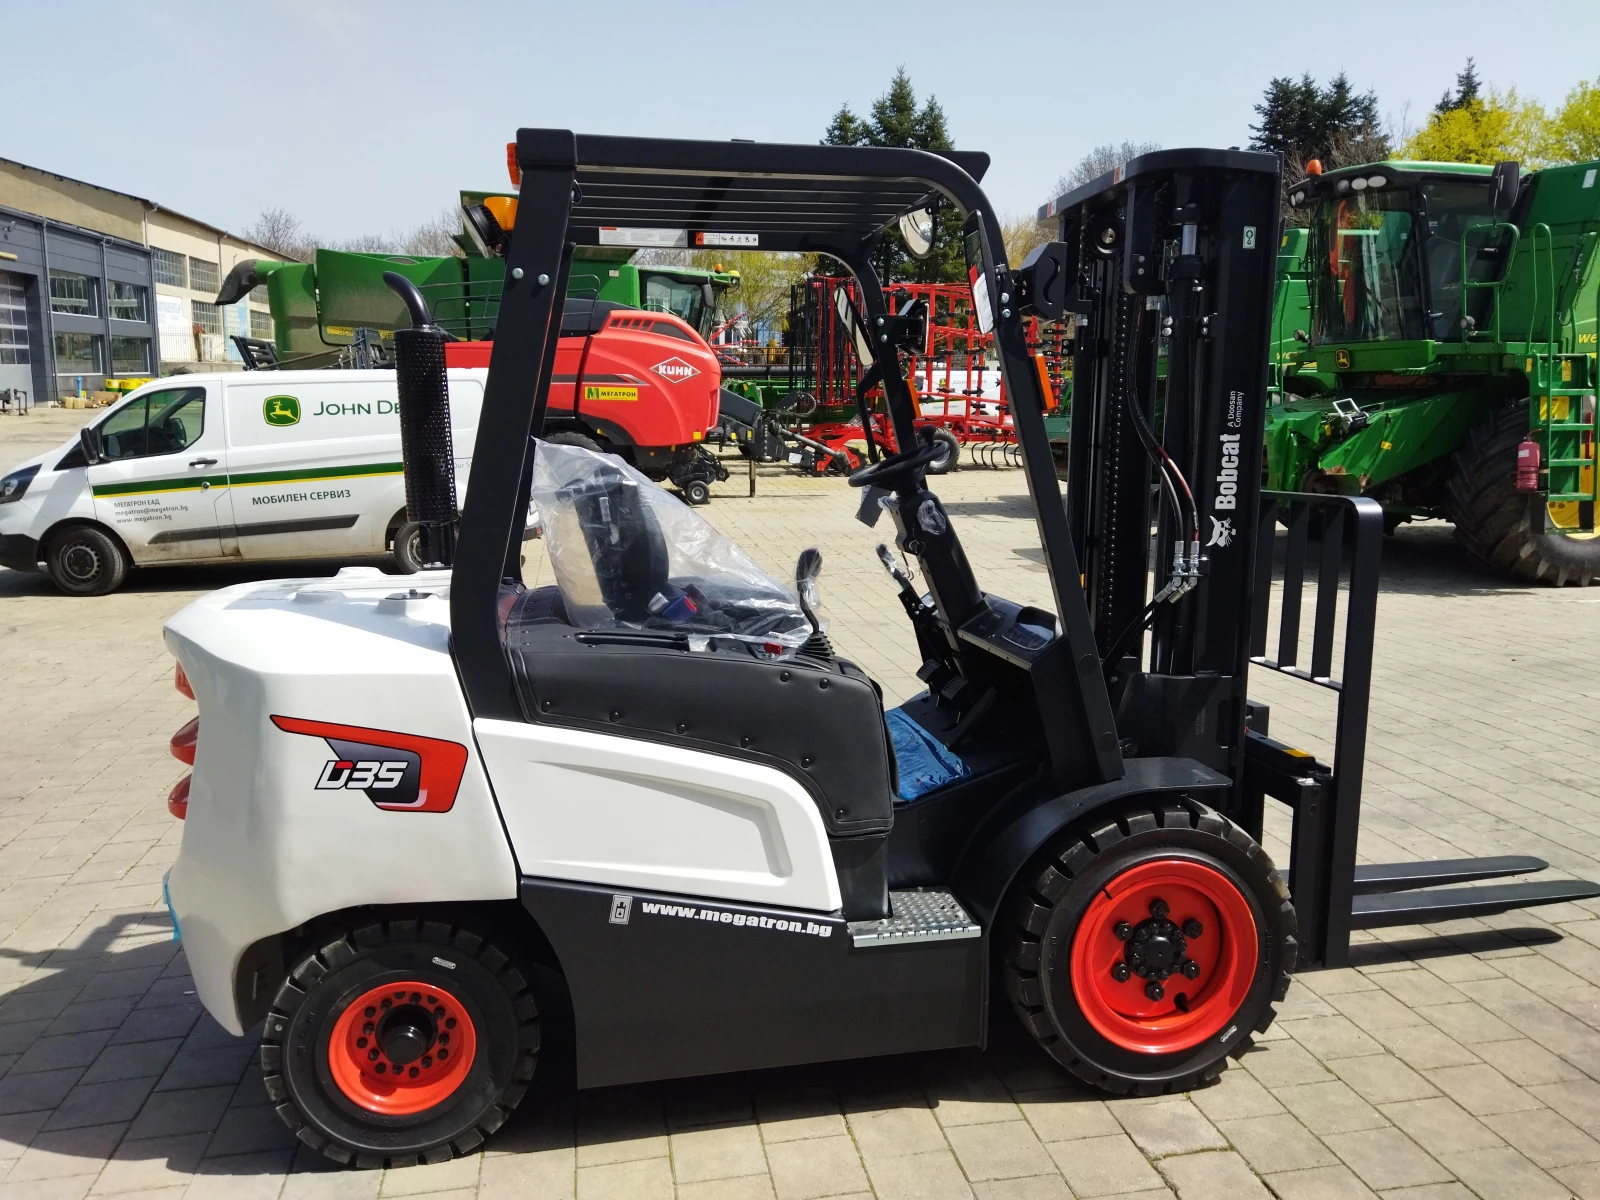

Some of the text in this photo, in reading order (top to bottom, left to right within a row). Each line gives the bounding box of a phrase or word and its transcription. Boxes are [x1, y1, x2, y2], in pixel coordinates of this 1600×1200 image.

[658, 364, 693, 376] KUHN
[313, 399, 400, 416] JOHN DE
[1228, 390, 1236, 419] Doosan
[1233, 391, 1244, 428] Company
[1215, 433, 1240, 509] Bobcat
[114, 498, 160, 508] МЕГАТРОН ЕАД
[252, 489, 351, 506] МОБИЛЕН СЕРВИЗ
[115, 505, 188, 516] megatron@megatron.bg
[117, 514, 172, 524] www.megatron.bg
[314, 760, 409, 790] D35
[642, 902, 833, 937] www.megatron.bg
